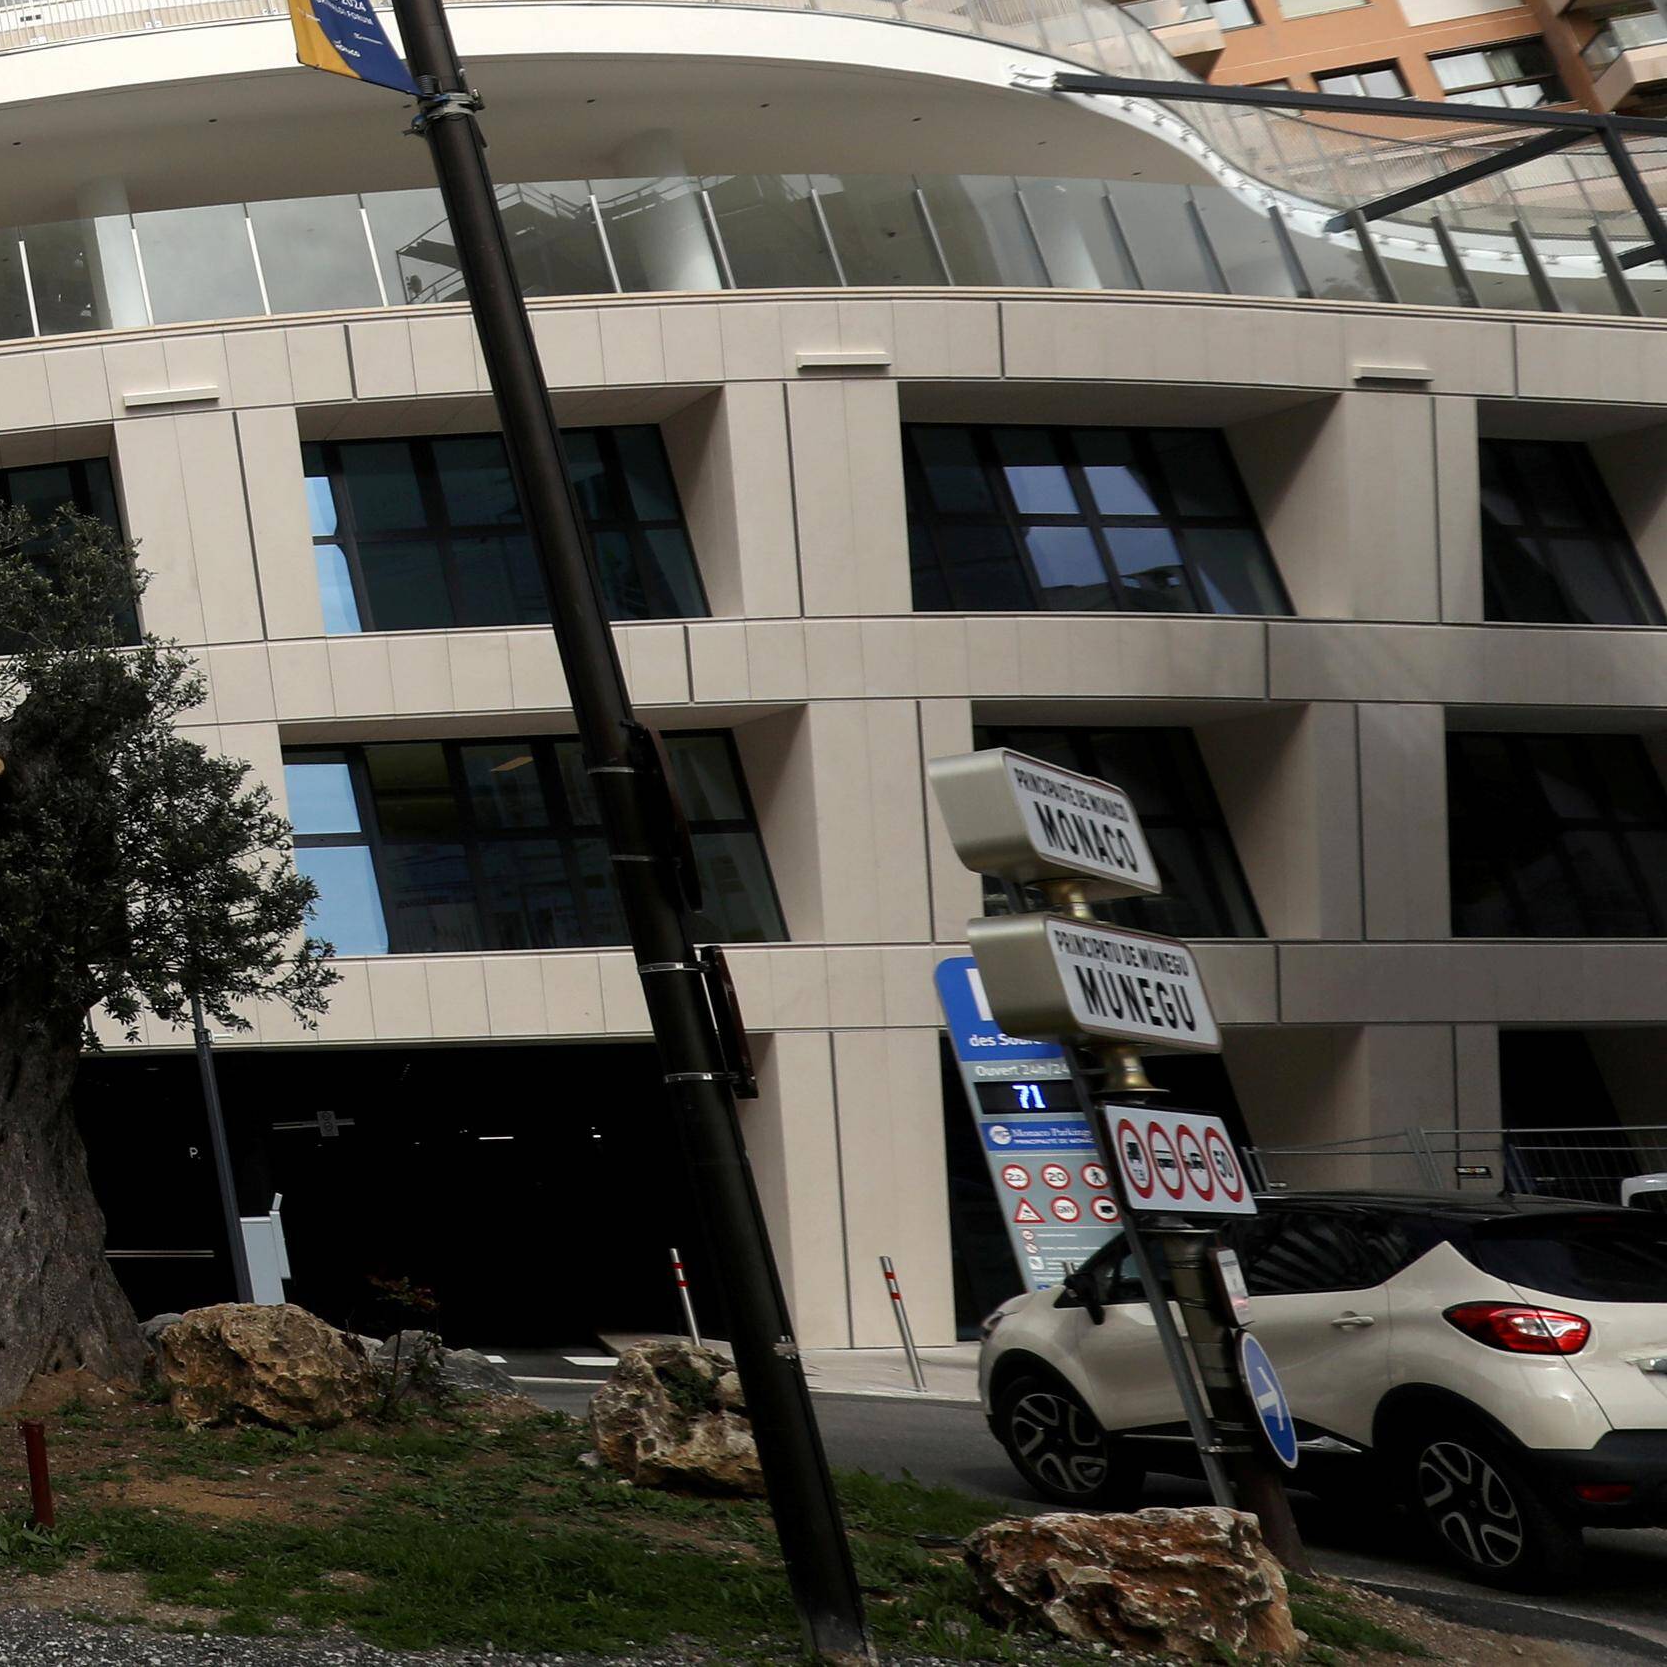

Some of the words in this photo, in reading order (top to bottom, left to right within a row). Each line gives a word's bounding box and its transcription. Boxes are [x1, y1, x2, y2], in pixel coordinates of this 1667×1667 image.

[1033, 800, 1139, 873] MONACO
[1120, 943, 1140, 968] DE
[969, 1034, 997, 1047] des
[975, 1065, 1018, 1077] Ouvert
[1012, 1084, 1046, 1109] 71
[1047, 1171, 1066, 1183] 20
[1213, 1150, 1235, 1179] 50
